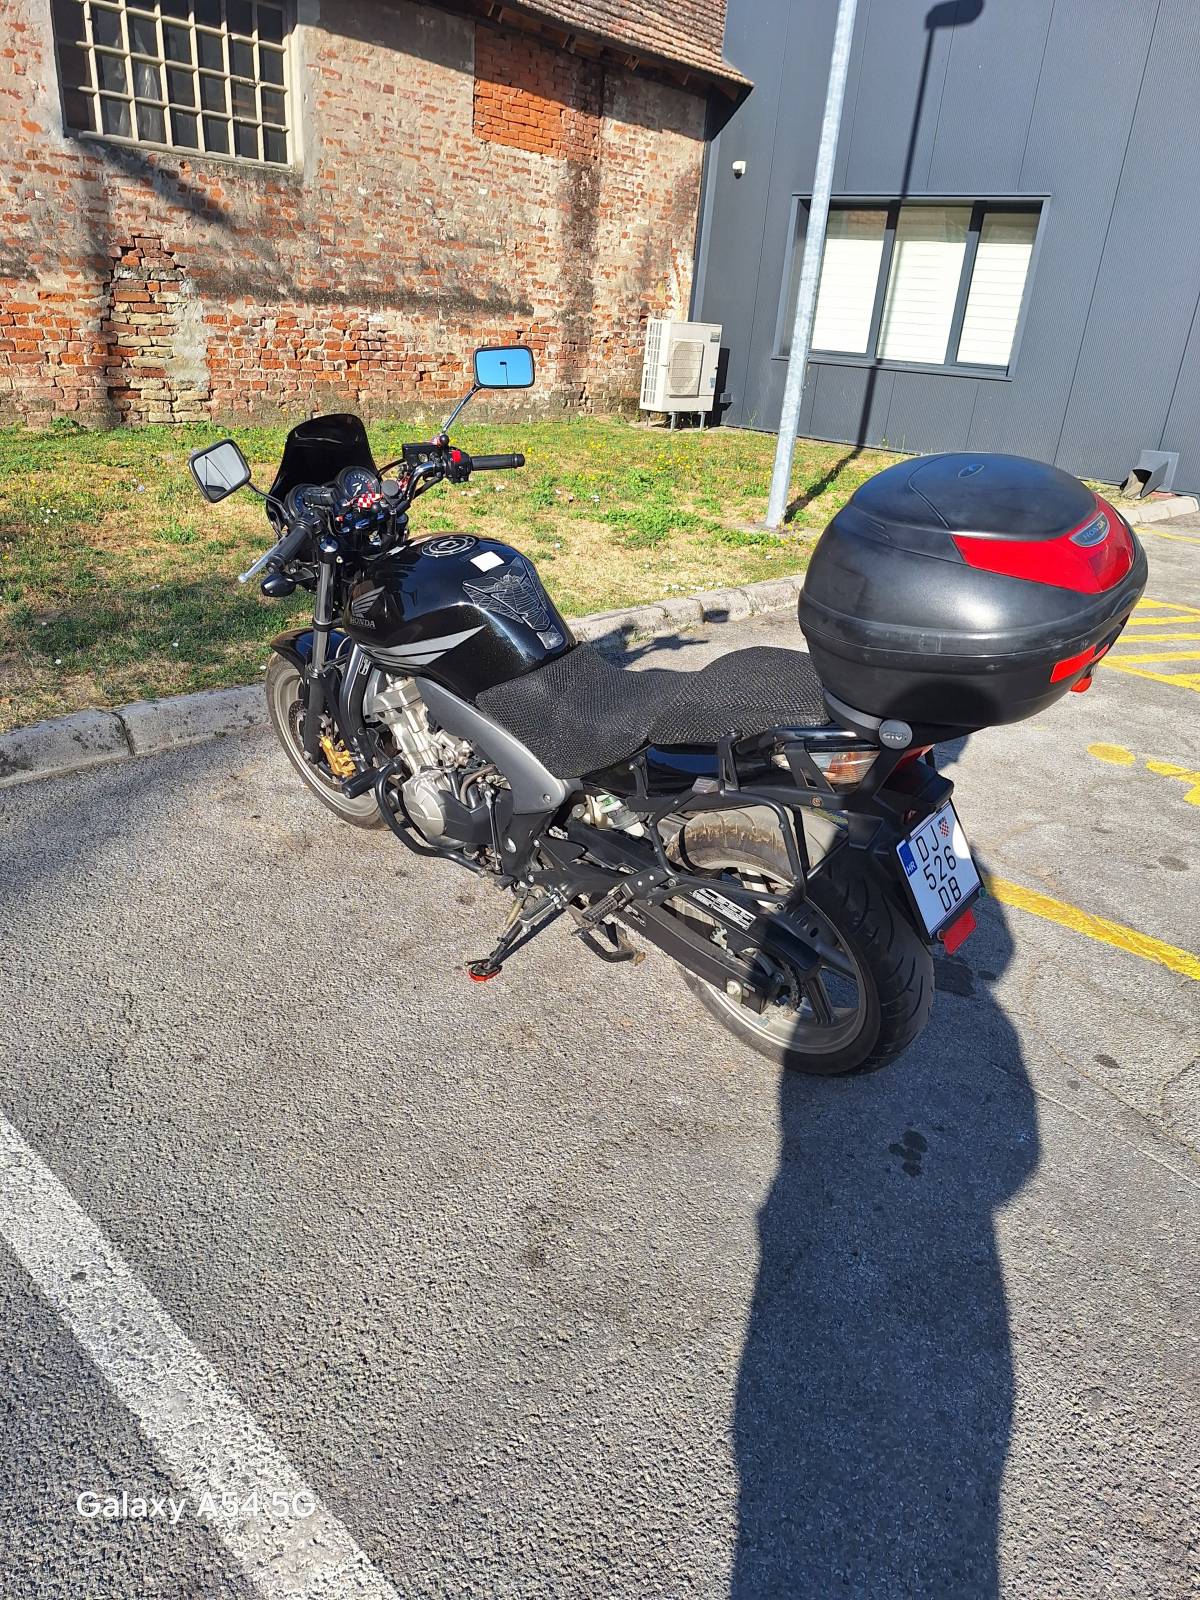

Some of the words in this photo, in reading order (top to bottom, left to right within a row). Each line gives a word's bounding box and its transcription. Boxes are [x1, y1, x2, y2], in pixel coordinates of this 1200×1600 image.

[915, 825, 940, 862] DJ
[906, 861, 917, 872] HR
[923, 846, 957, 890] 526
[938, 876, 962, 912] DB
